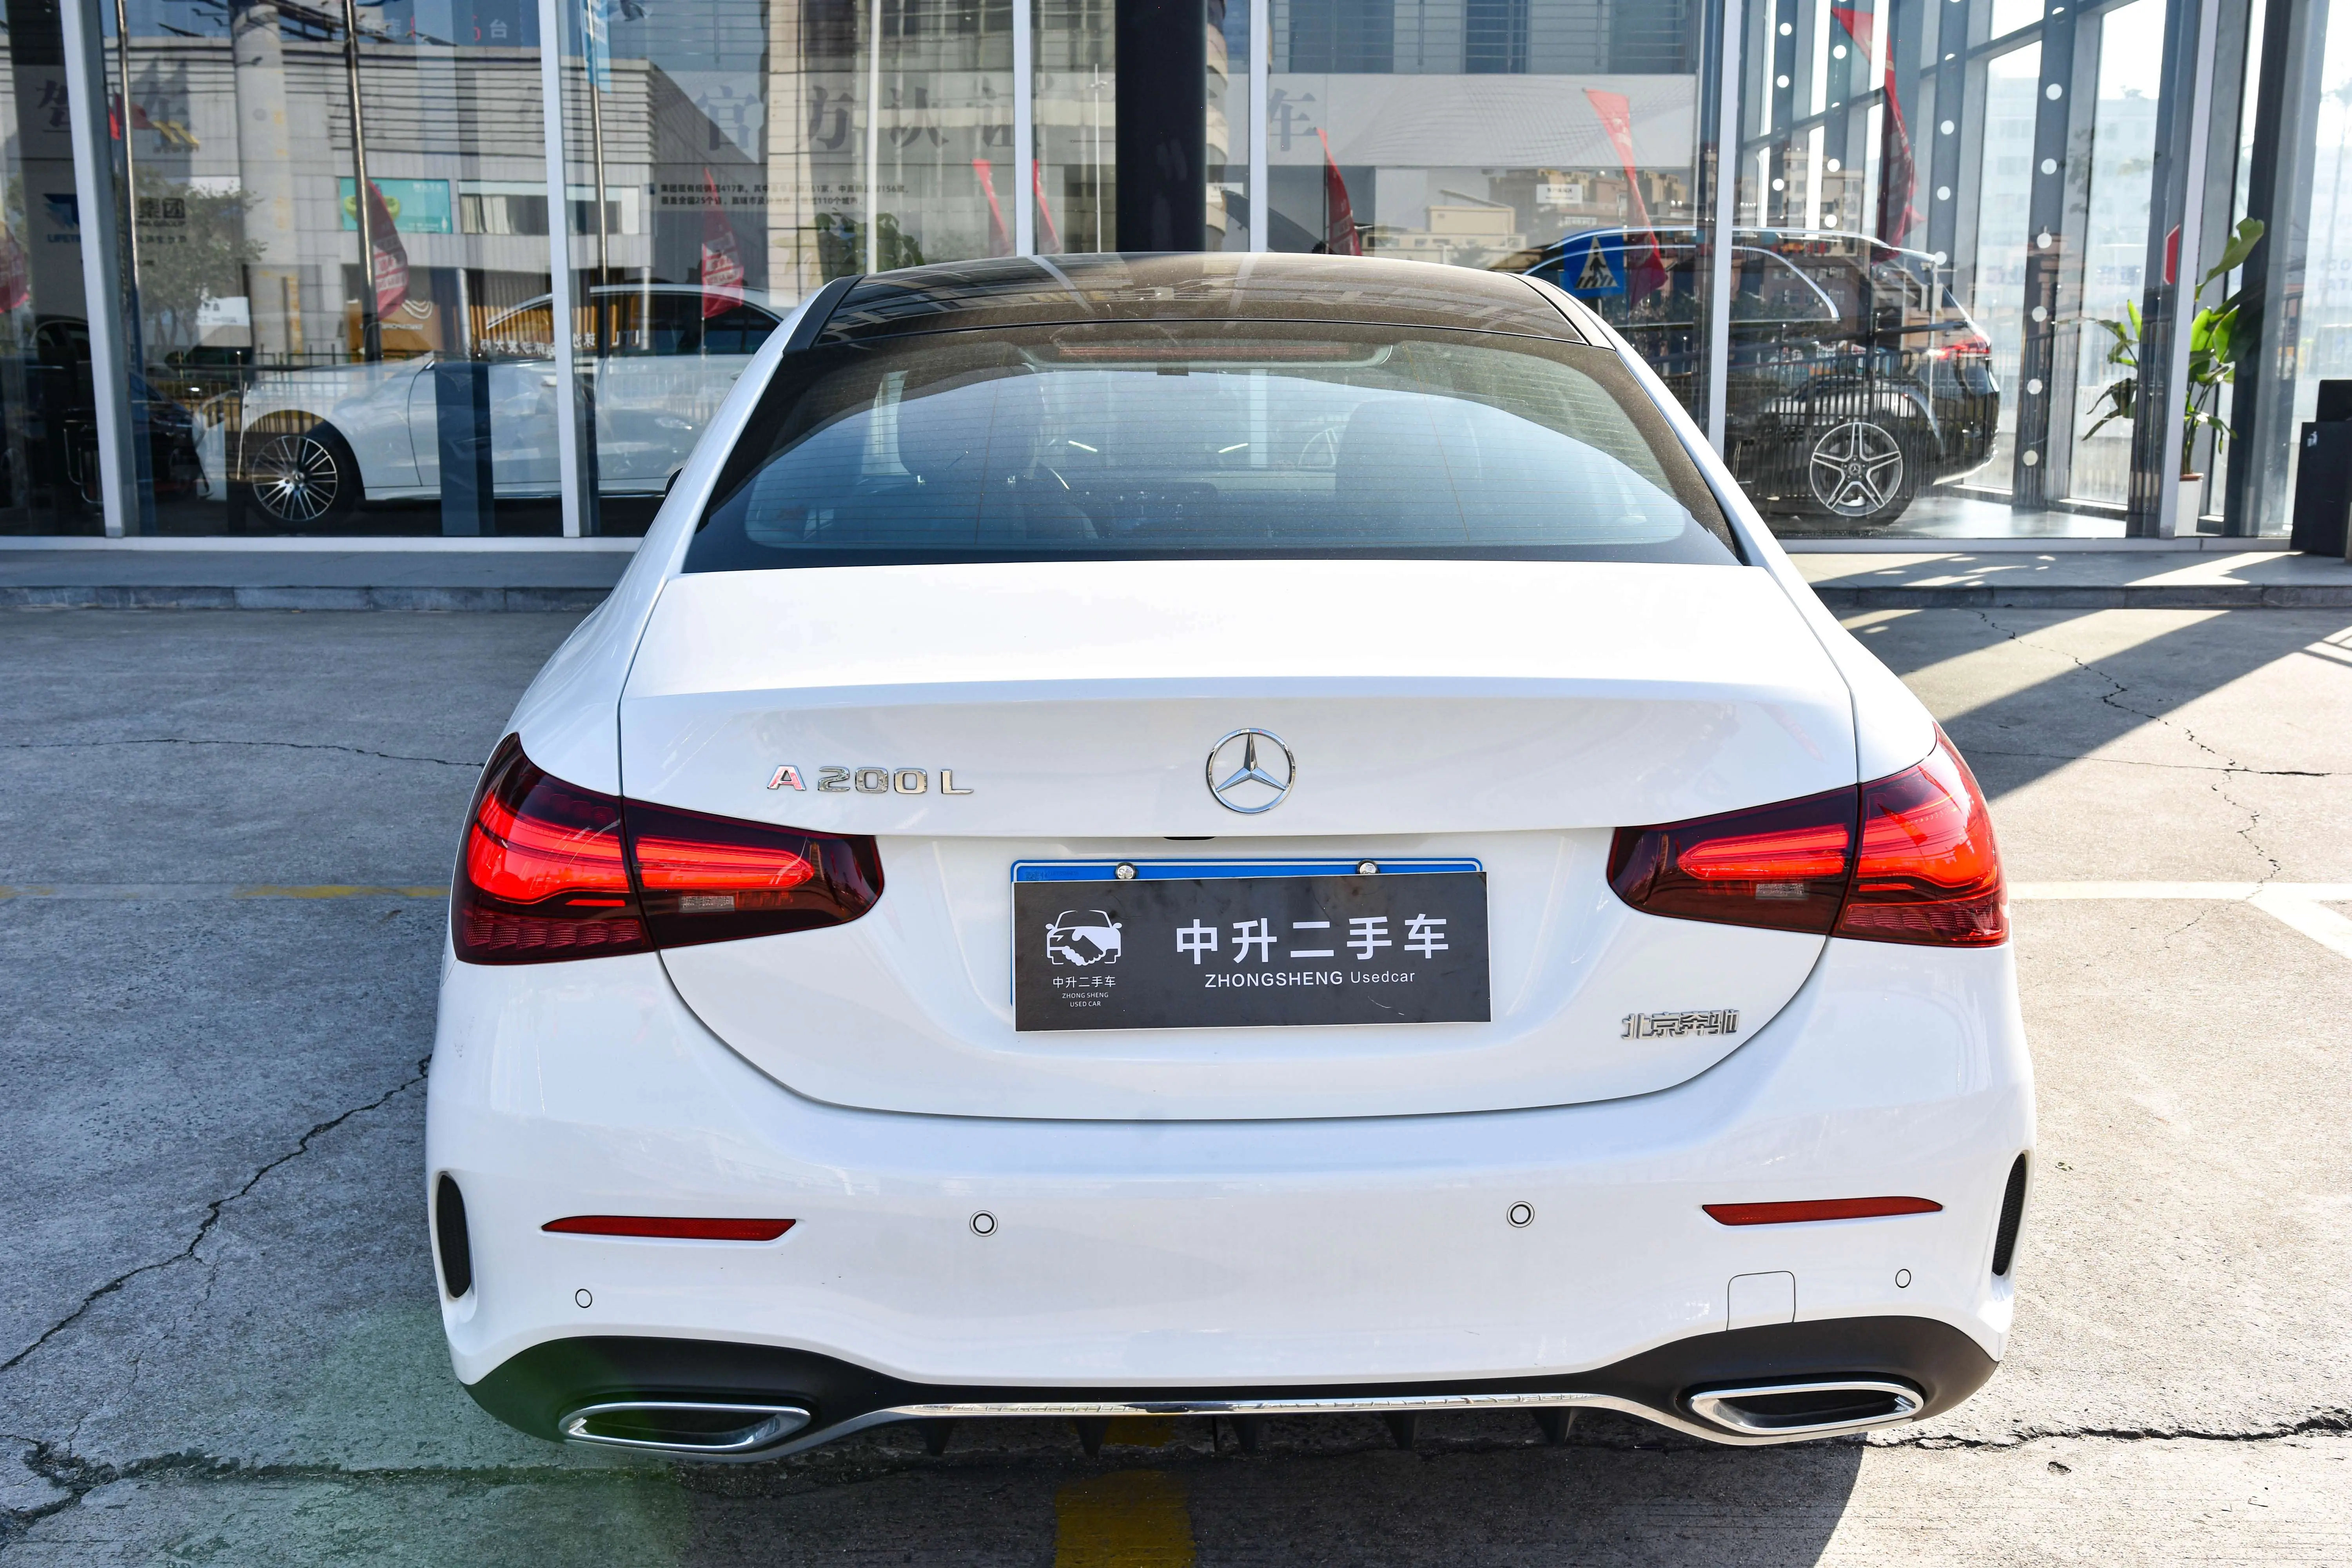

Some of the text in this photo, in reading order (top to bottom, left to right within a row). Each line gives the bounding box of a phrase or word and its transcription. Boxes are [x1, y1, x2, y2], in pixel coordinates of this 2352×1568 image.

[767, 765, 974, 795] A 200 L
[1177, 914, 1448, 964] 中升二手车
[1053, 976, 1116, 988] 中升二手车
[1205, 971, 1415, 987] ZHONGSHENG Usedcar
[1621, 1009, 1740, 1040] 北京奔驰
